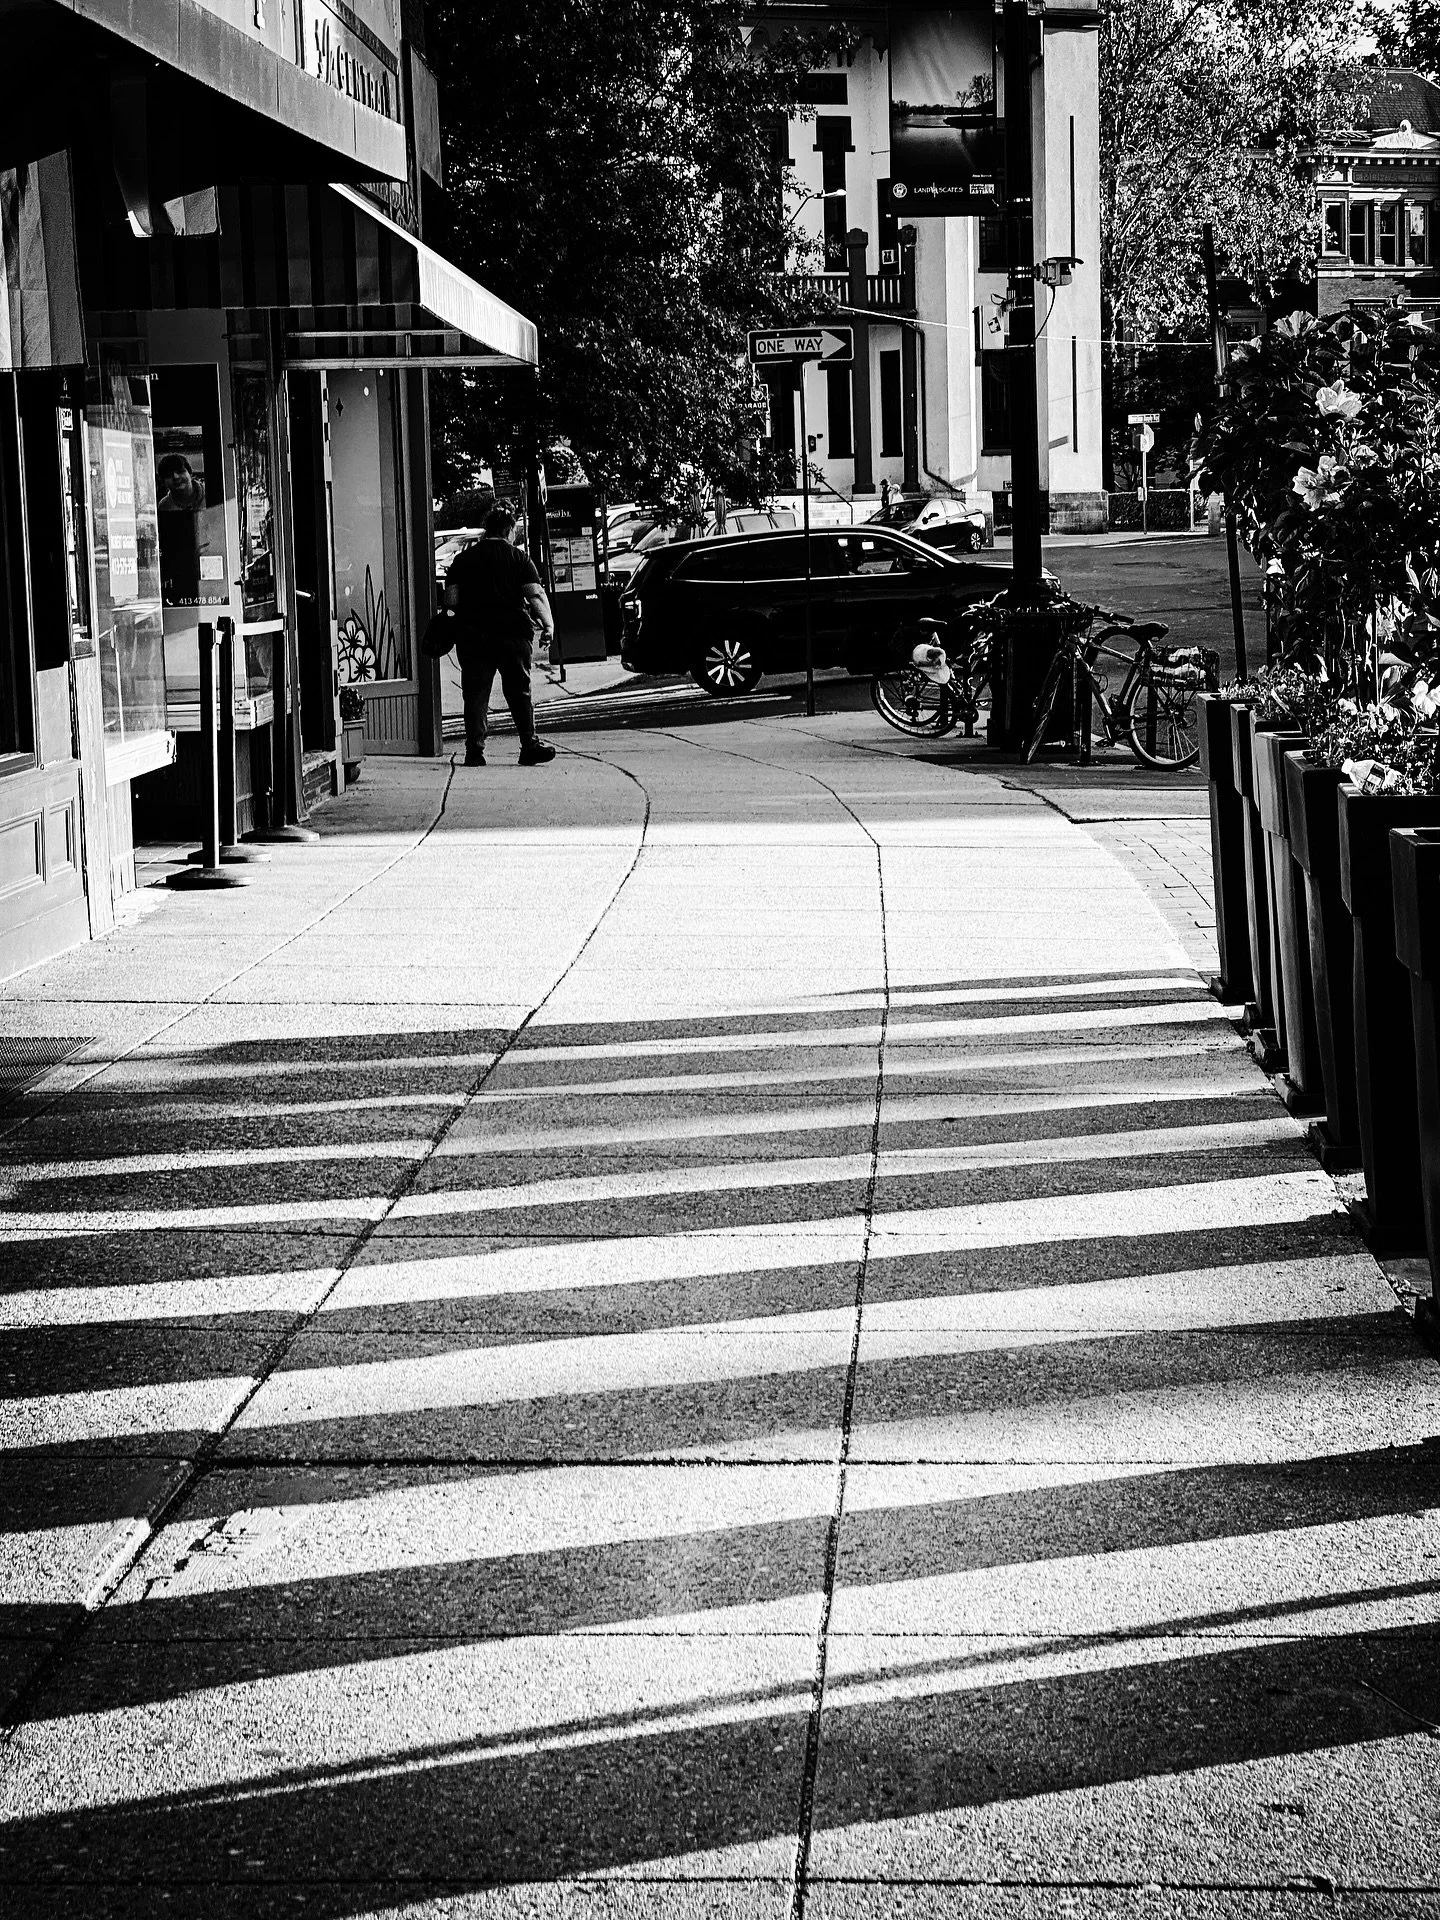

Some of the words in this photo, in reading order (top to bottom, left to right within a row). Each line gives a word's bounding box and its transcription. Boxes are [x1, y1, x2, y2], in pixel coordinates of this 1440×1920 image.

[757, 340, 785, 353] ONE
[794, 338, 823, 351] WAY
[179, 597, 193, 605] 413
